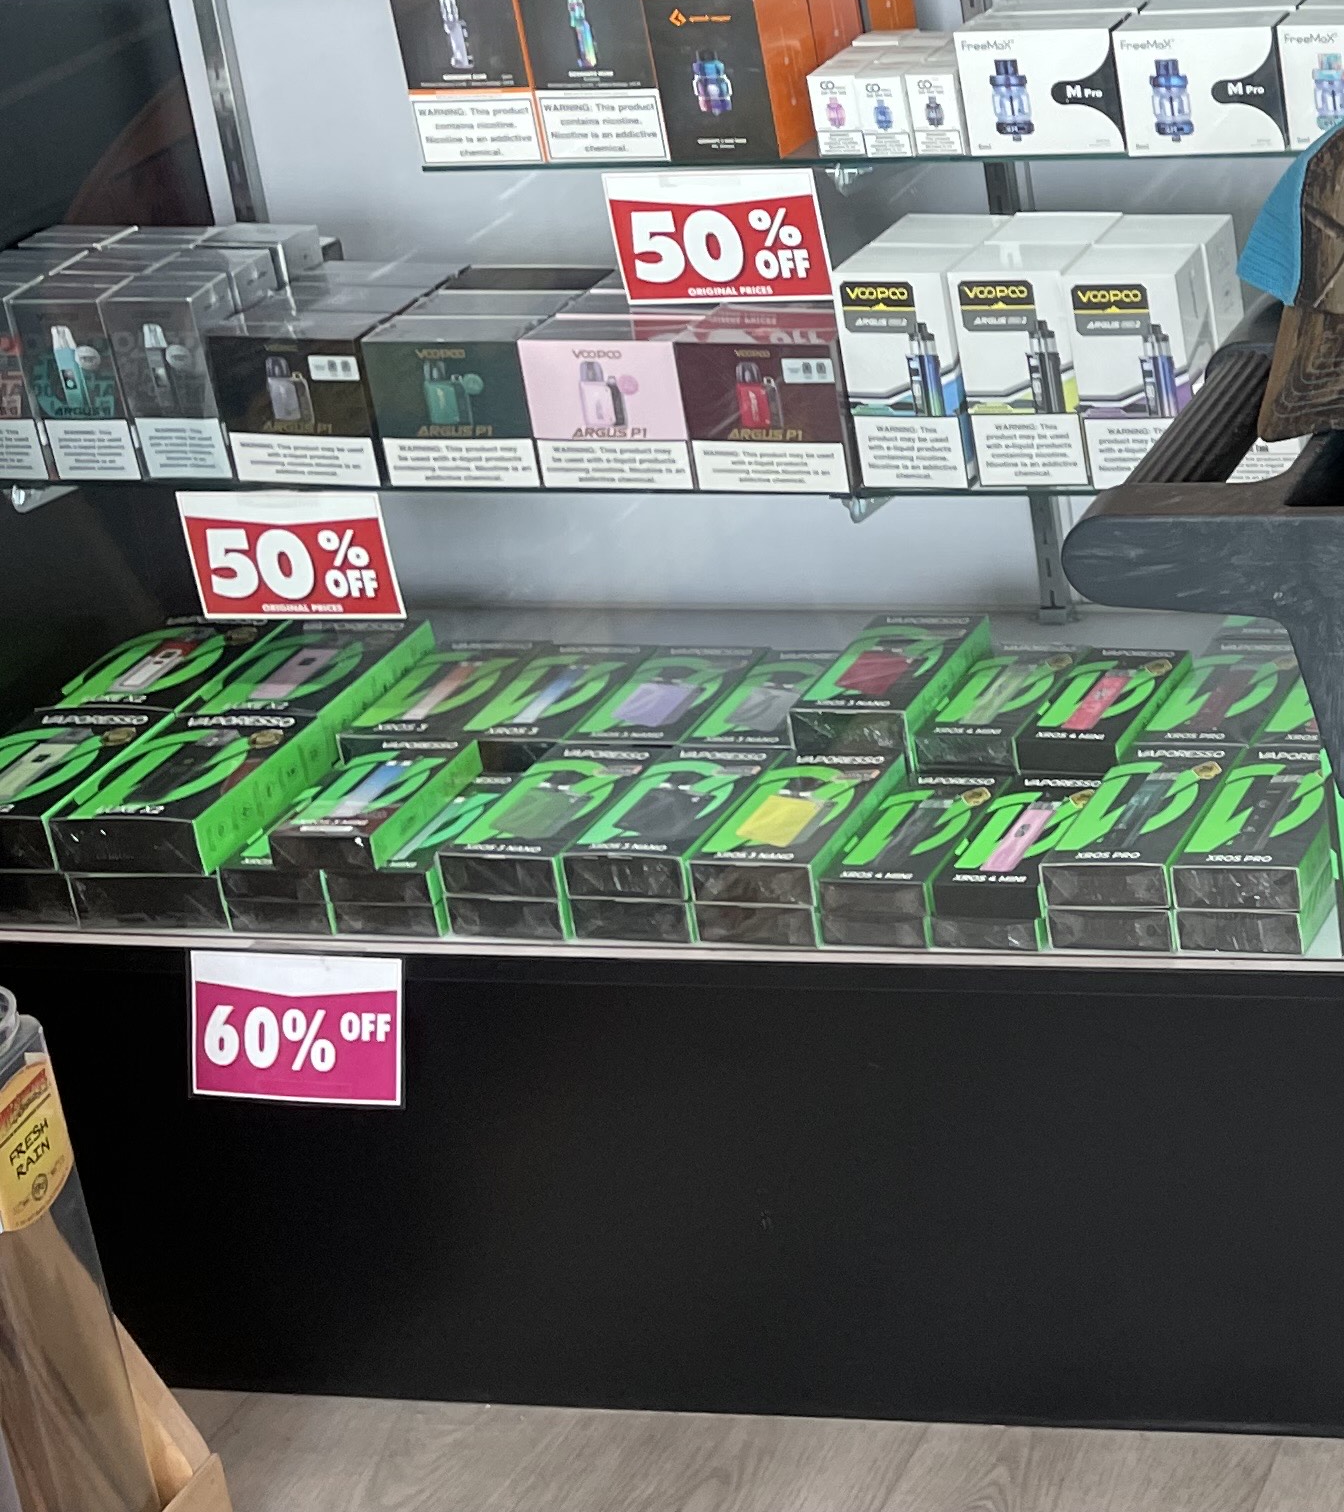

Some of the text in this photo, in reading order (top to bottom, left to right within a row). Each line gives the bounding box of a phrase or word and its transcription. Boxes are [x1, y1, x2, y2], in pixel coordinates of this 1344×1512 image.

[1065, 85, 1103, 100] M Pro
[755, 249, 810, 282] OFF
[687, 284, 773, 298] ORIGINAL PRICES
[845, 285, 911, 303] VOOPOO
[572, 348, 622, 360] VOOPOO
[572, 425, 648, 438] ARGUS P1
[325, 569, 379, 598] OFF
[203, 1004, 392, 1073] 60% OFF
[8, 1117, 50, 1168] FRESH
[15, 1138, 52, 1180] RAIN
